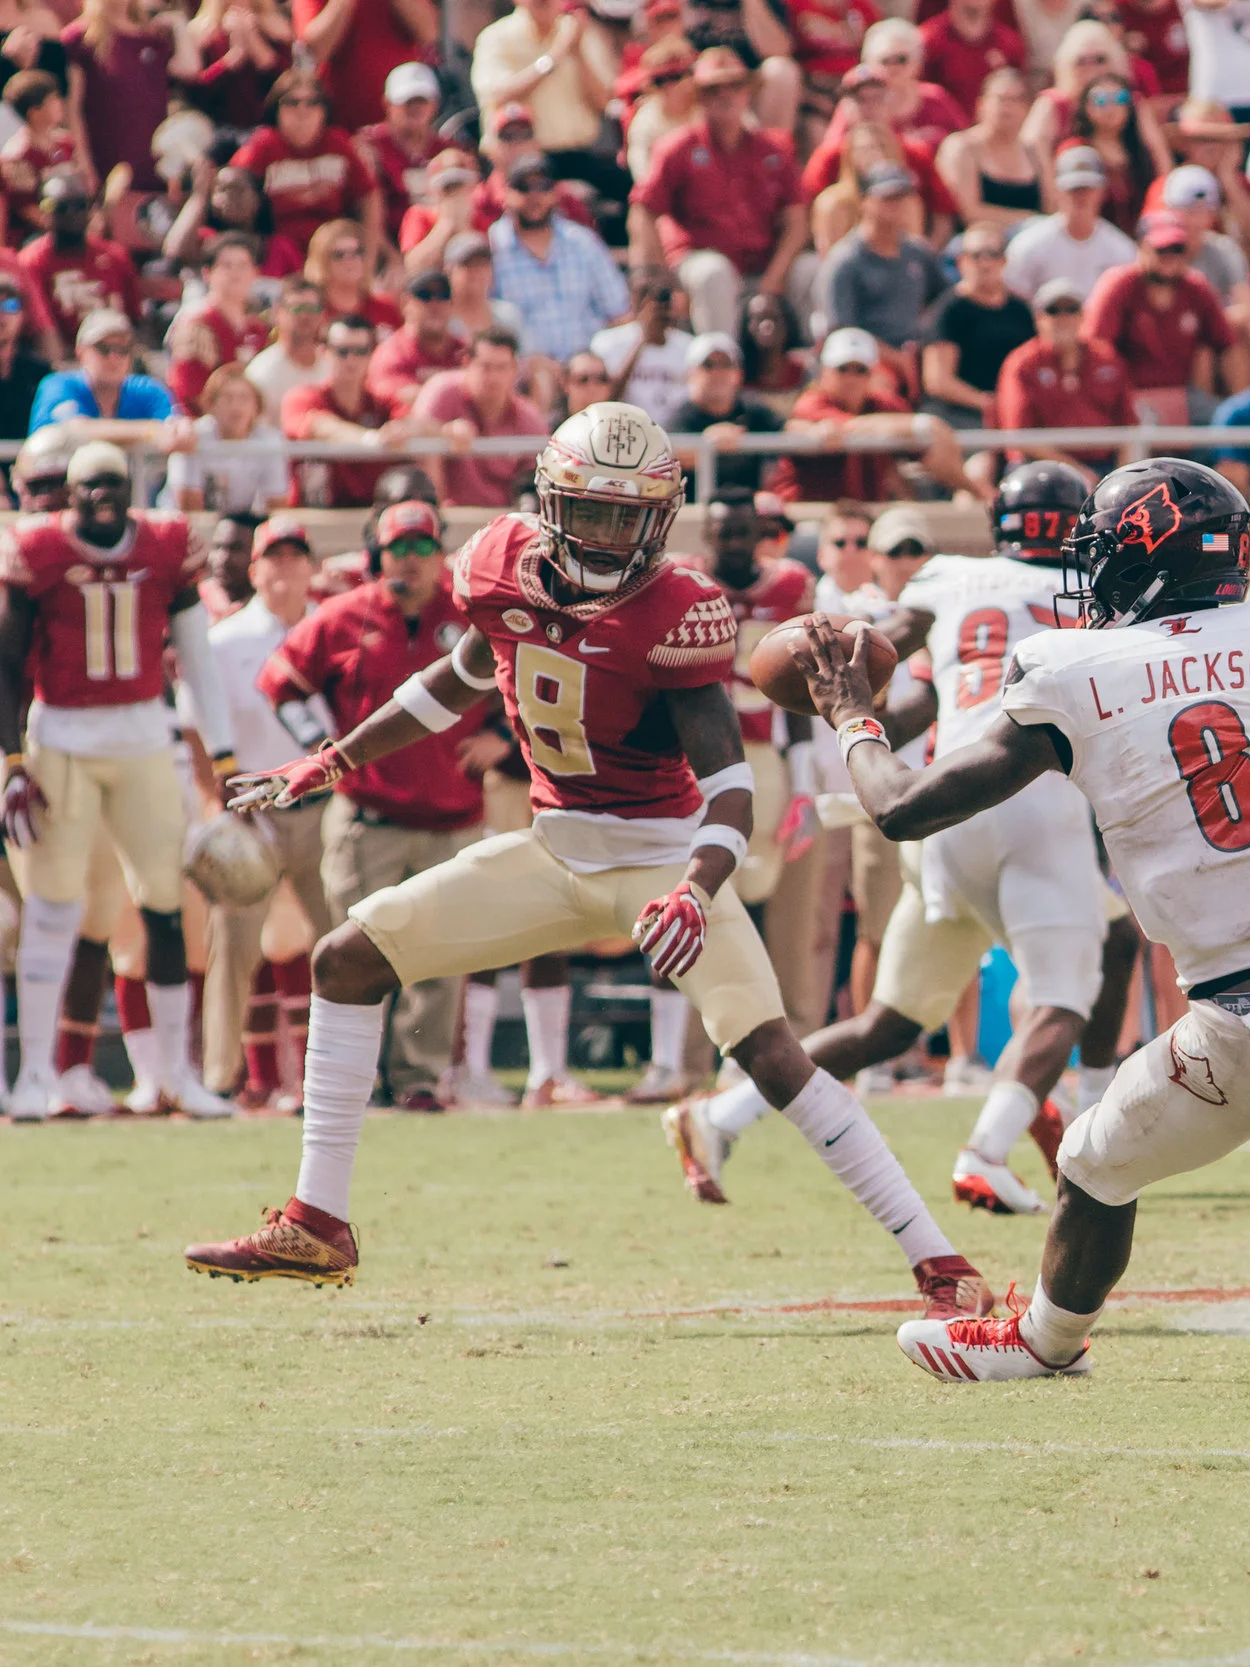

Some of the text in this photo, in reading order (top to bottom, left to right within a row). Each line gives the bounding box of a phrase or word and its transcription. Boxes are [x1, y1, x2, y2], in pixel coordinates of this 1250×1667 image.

[565, 470, 580, 484] NIKE
[603, 479, 627, 488] ACC
[1024, 511, 1060, 539] 87
[1238, 533, 1249, 568] 8
[80, 582, 139, 681] 11
[506, 613, 529, 627] ACC
[516, 641, 597, 776] 8
[1089, 676, 1124, 721] L.
